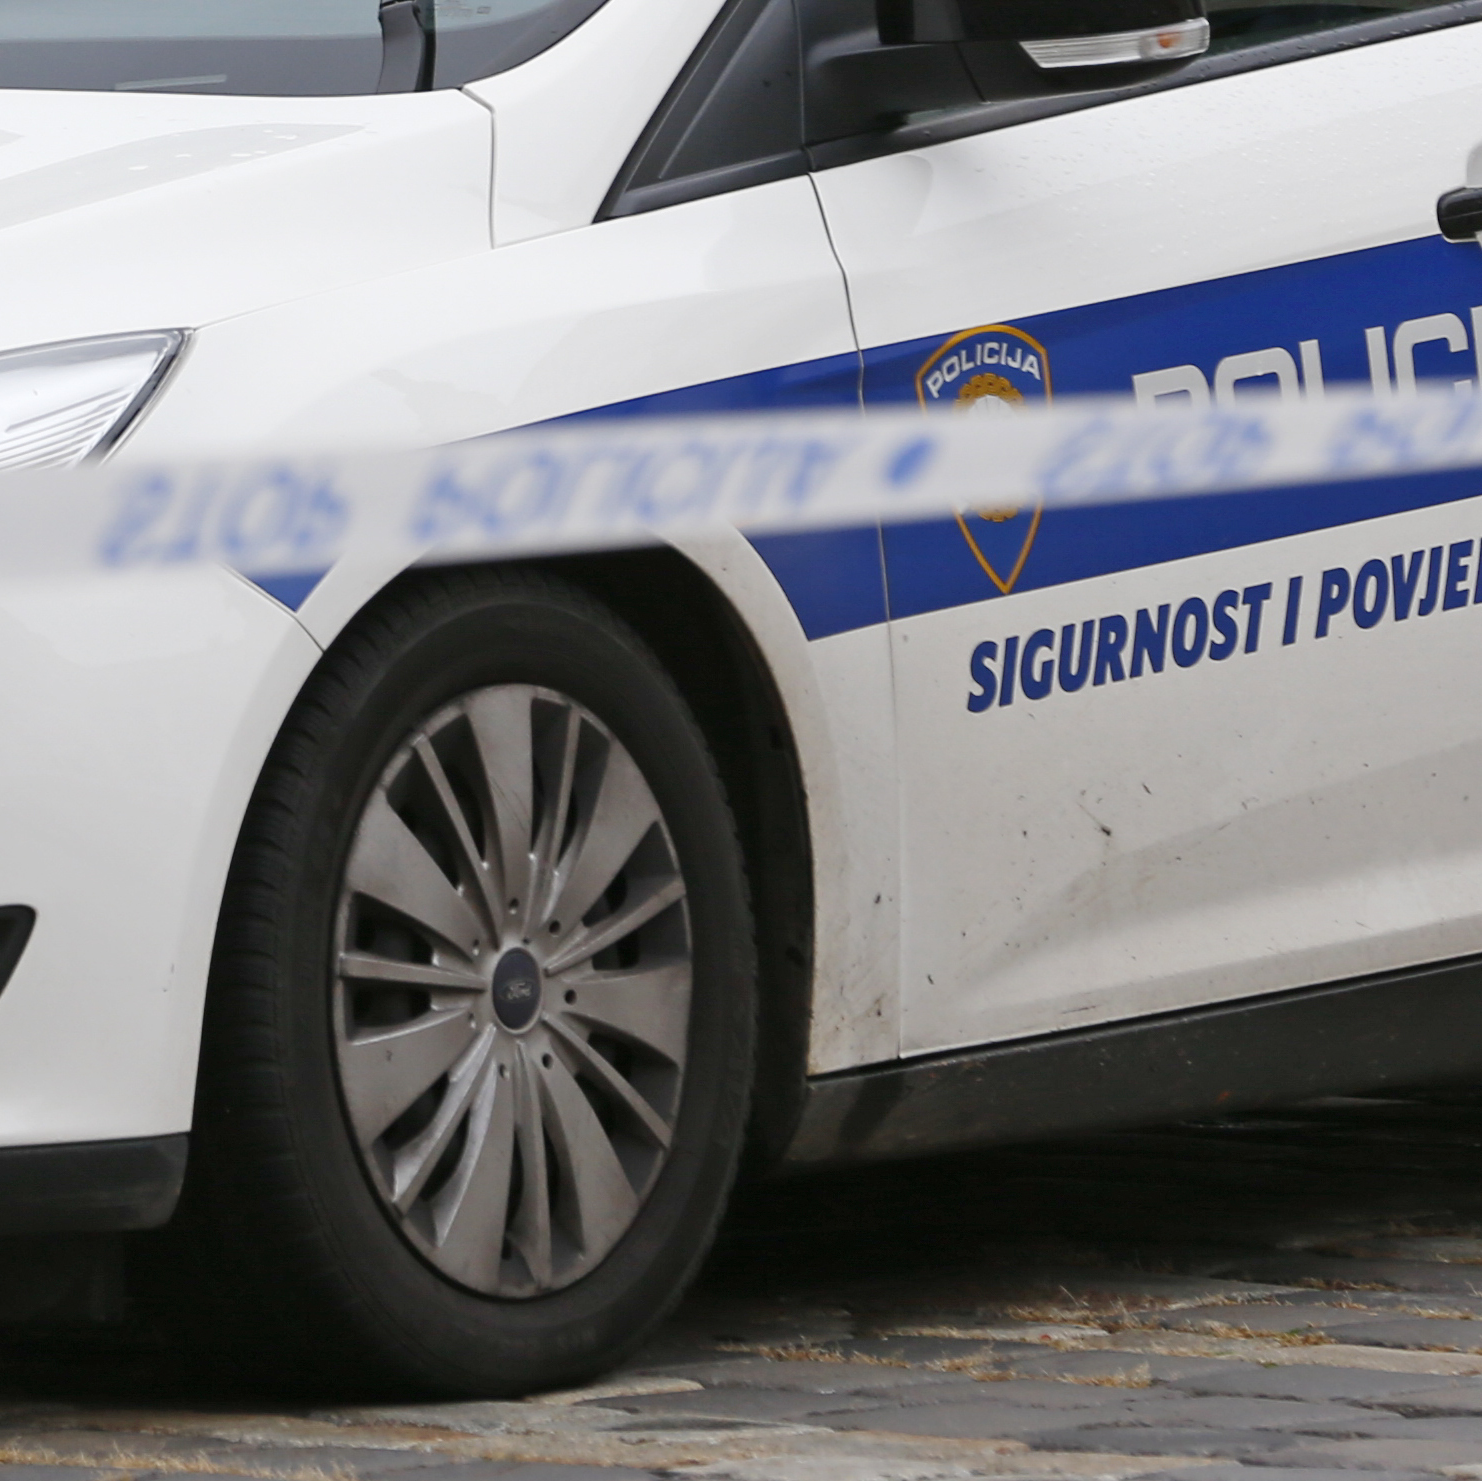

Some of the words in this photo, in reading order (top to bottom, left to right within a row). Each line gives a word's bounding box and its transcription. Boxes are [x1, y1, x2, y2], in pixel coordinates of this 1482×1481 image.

[926, 342, 1041, 399] POLICIJA
[967, 582, 1272, 713] SIGURNOST
[1283, 576, 1303, 646] I
